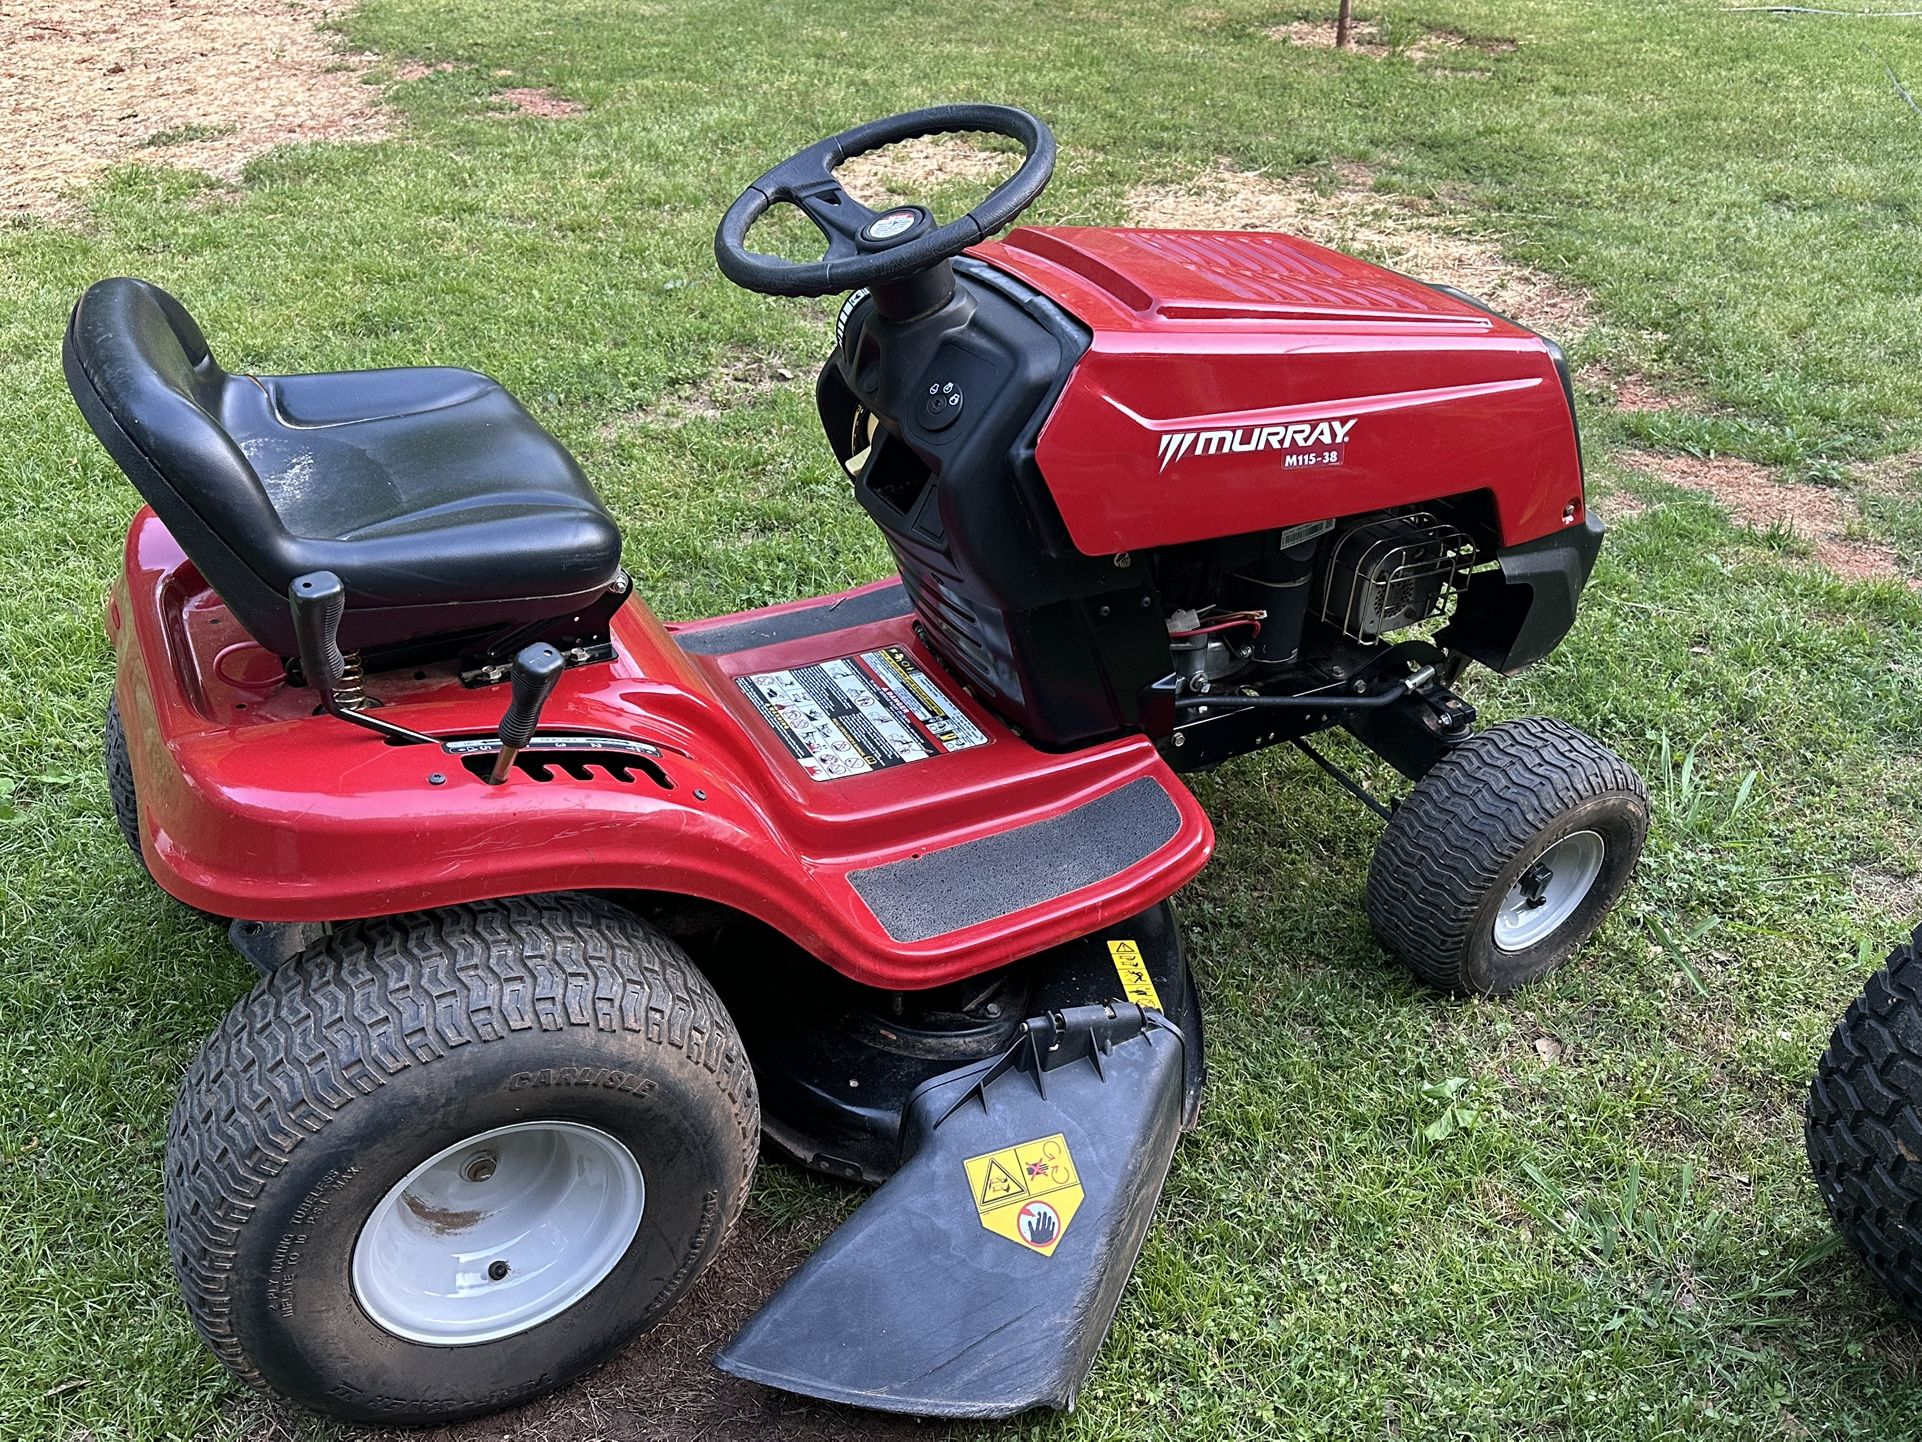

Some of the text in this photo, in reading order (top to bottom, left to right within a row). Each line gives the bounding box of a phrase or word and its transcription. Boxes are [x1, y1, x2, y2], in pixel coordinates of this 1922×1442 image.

[1284, 451, 1338, 467] M115-38
[508, 1067, 659, 1098] CARLISLE
[290, 1168, 340, 1225] TUBELESS
[271, 1233, 295, 1273] RATING
[287, 1252, 300, 1266] TO
[266, 1278, 280, 1301] PLY
[280, 1274, 295, 1318] INFLATE
